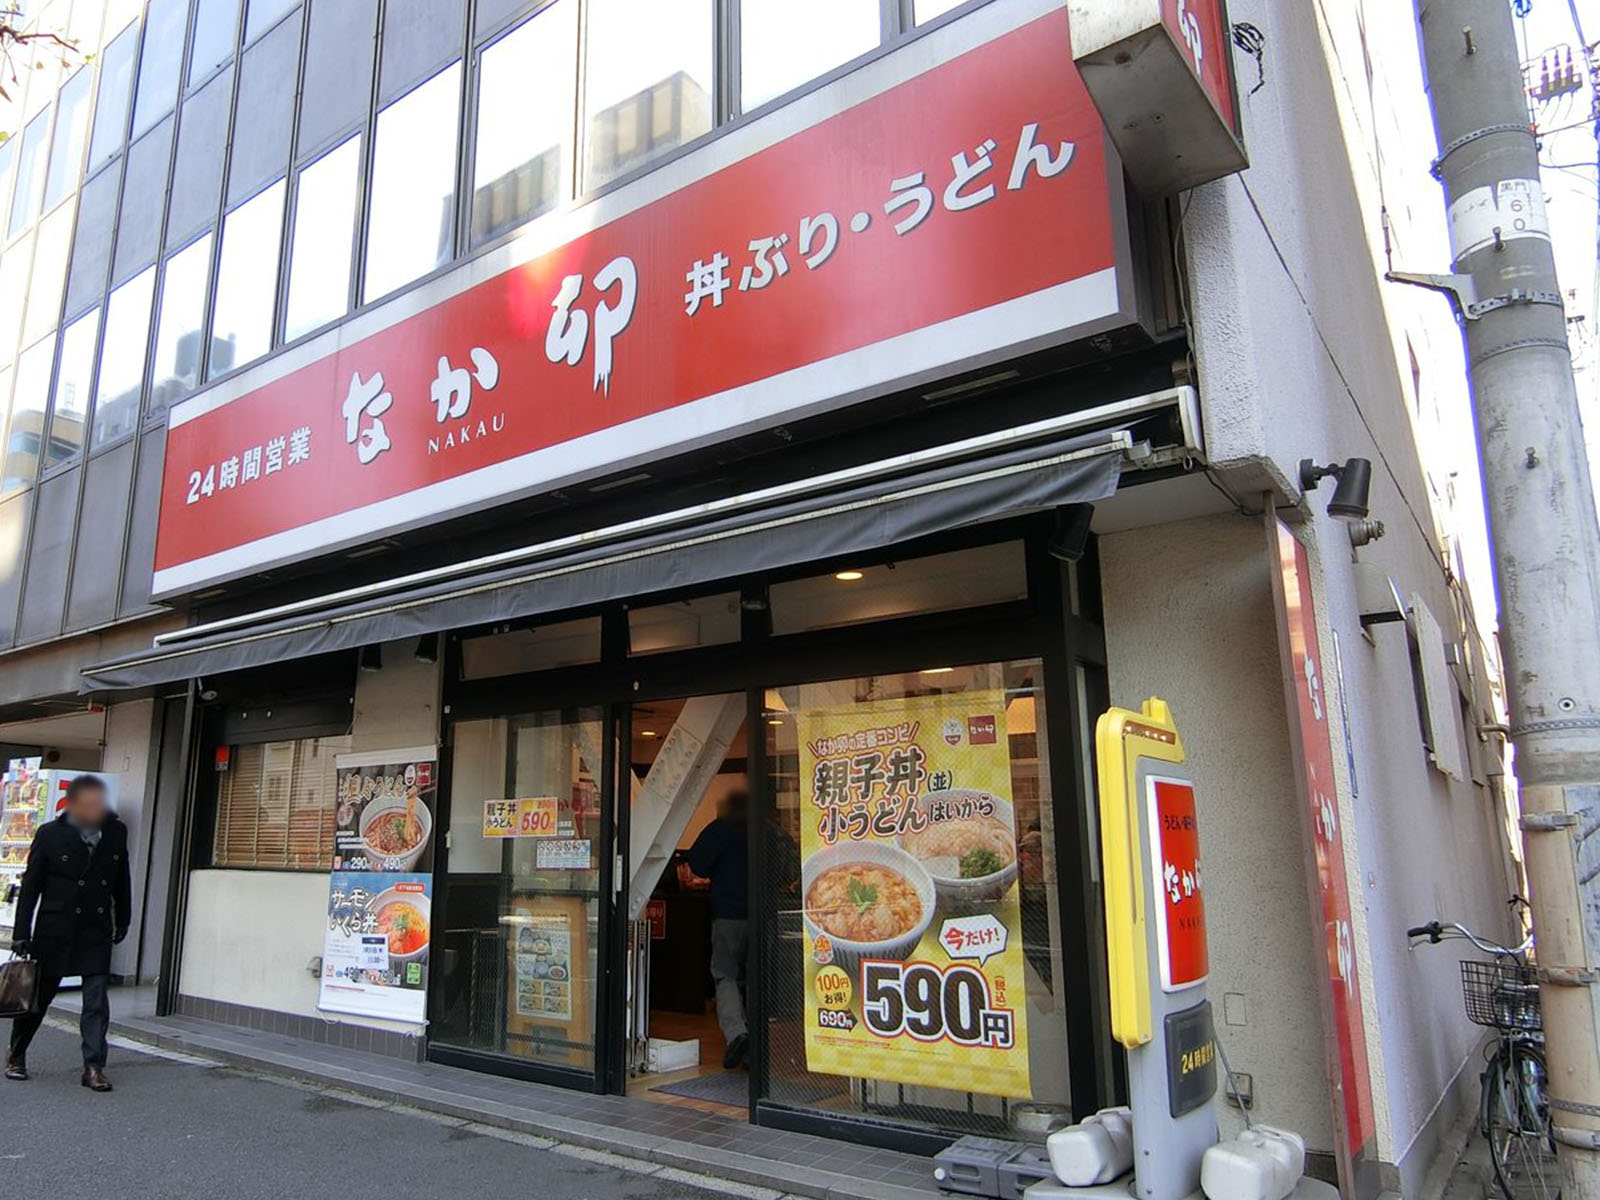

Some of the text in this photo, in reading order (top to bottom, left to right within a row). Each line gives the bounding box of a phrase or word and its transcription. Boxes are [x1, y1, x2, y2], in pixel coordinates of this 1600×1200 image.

[684, 122, 1076, 317] 丼ぶり・うどん
[342, 255, 638, 466] なか卯
[428, 412, 505, 455] NAKAU
[185, 427, 313, 505] 24時間営業
[815, 746, 924, 805] 親子丼
[521, 811, 550, 831] 590
[819, 795, 994, 842] 小うどん はいから
[331, 888, 376, 909] サーモン
[944, 927, 1001, 951] 今だけ!
[817, 973, 849, 991] 100円
[863, 962, 1011, 1046] 590円
